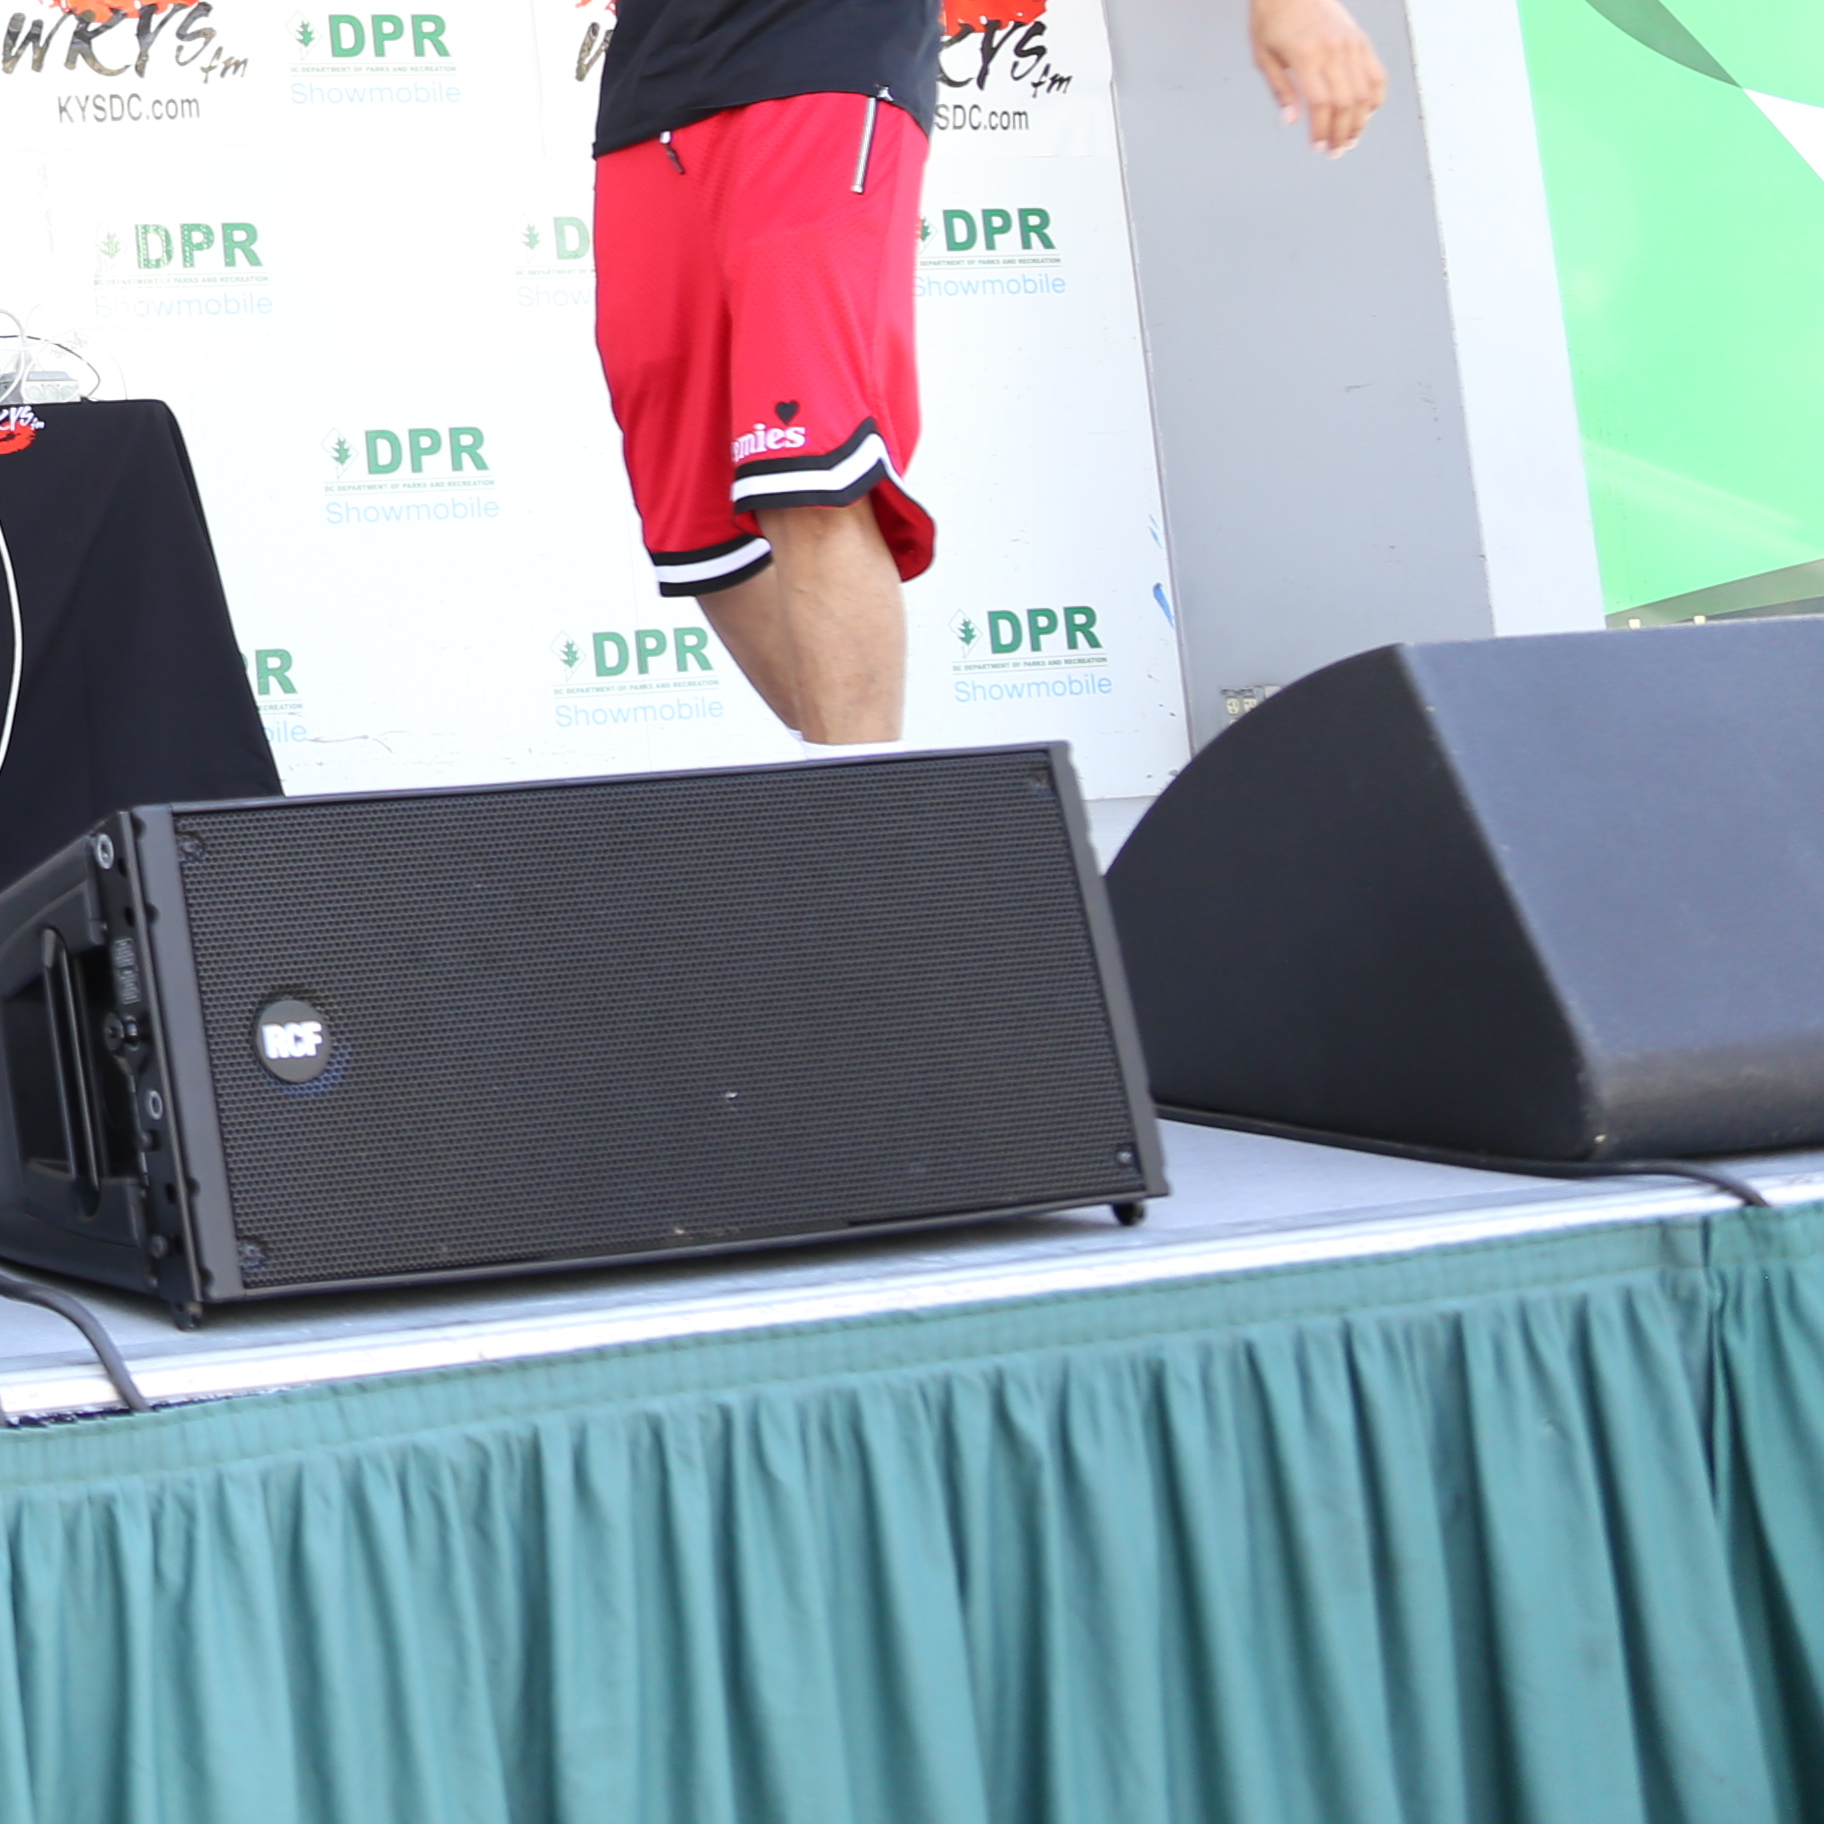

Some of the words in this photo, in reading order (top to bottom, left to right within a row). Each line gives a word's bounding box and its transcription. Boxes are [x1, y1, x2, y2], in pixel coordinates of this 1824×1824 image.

[1, 2, 216, 78] WKYS
[200, 46, 249, 84] fm
[328, 14, 451, 58] DPR
[291, 82, 461, 105] Showmobile
[1030, 68, 1074, 98] fm
[58, 93, 201, 123] KYSDC.com
[934, 104, 1030, 132] SDC.com
[942, 207, 1057, 252] DPR
[134, 222, 264, 269] DPR
[916, 273, 1067, 297] Showmobile
[95, 292, 273, 318] Showmobile
[30, 418, 47, 430] fm
[365, 426, 490, 475] DPR
[325, 496, 499, 524] Showmobile
[987, 606, 1104, 654] DPR
[593, 627, 714, 677] DPR
[964, 663, 1010, 671] DEPARTMENT
[566, 686, 615, 694] DEPARTMENT
[673, 680, 720, 688] RECREATION
[954, 674, 1112, 703] Showmobile
[555, 697, 724, 727] Showmobile
[262, 1020, 323, 1059] RCF
